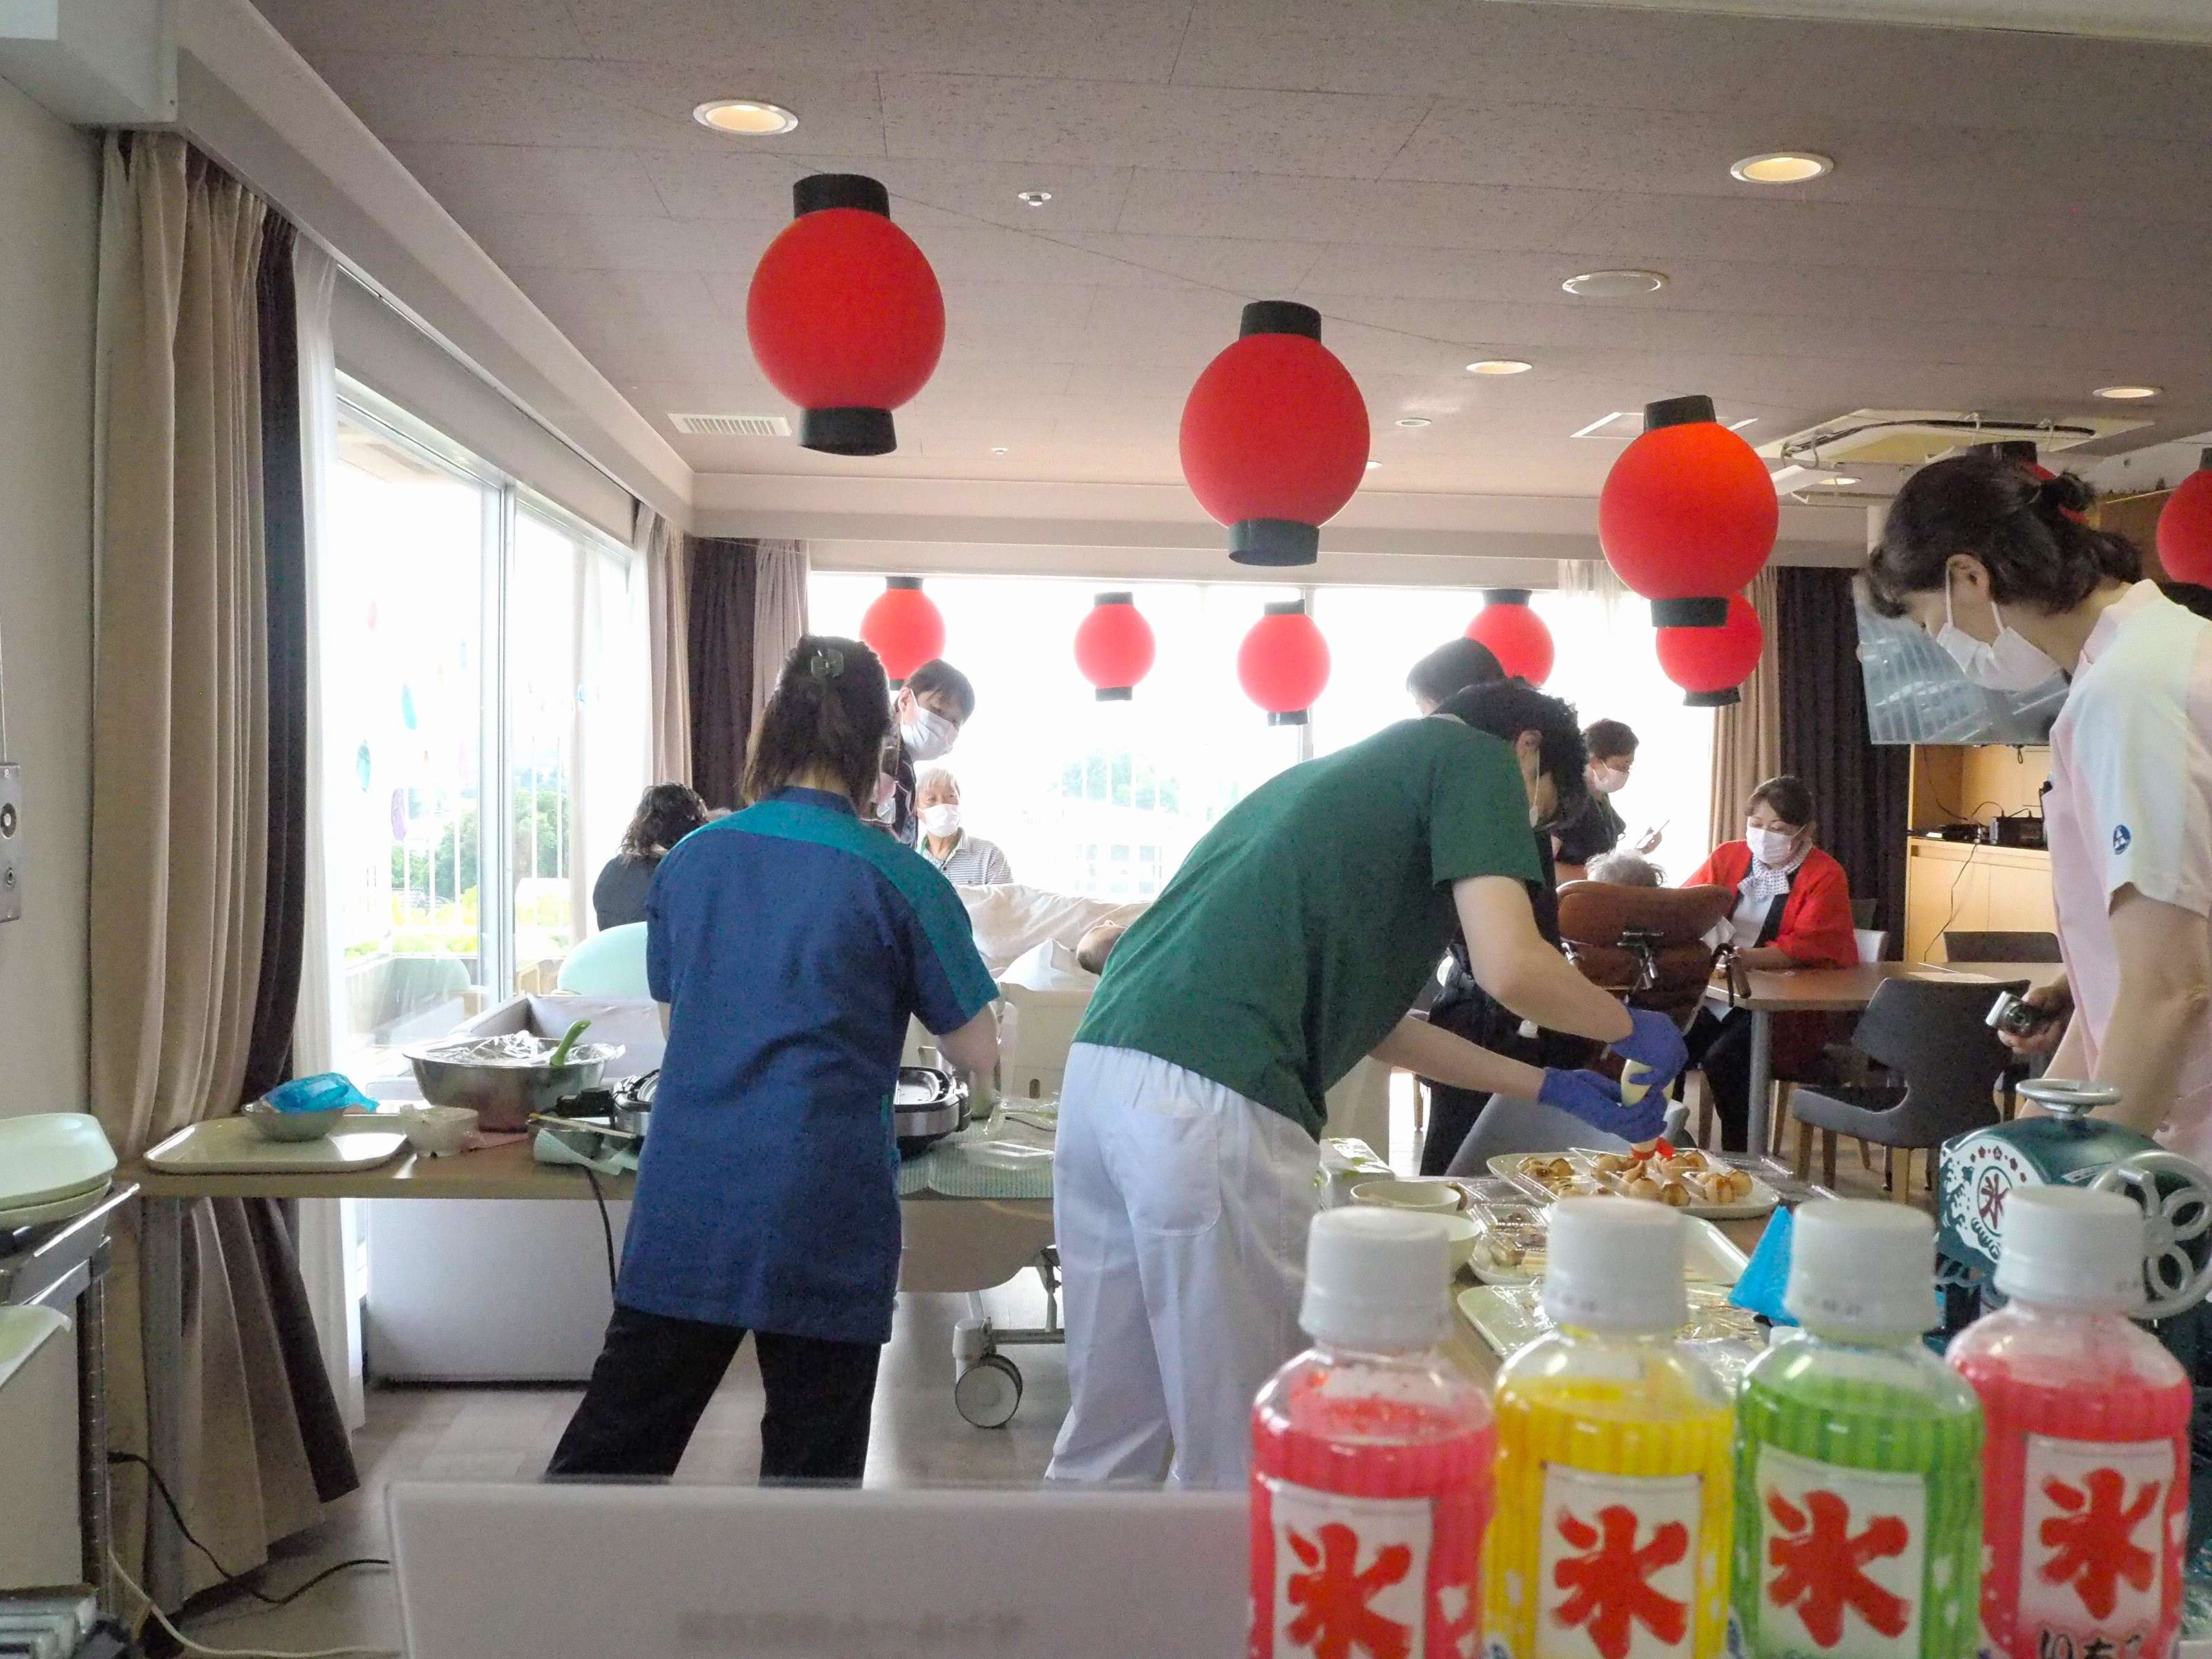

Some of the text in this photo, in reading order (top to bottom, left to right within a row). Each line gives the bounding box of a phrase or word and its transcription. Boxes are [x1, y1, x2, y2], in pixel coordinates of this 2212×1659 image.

[1286, 1522, 1413, 1659] 氷
[1553, 1504, 1691, 1659] 氷
[1765, 1489, 1910, 1648] 氷
[2038, 1467, 2162, 1621] 氷
